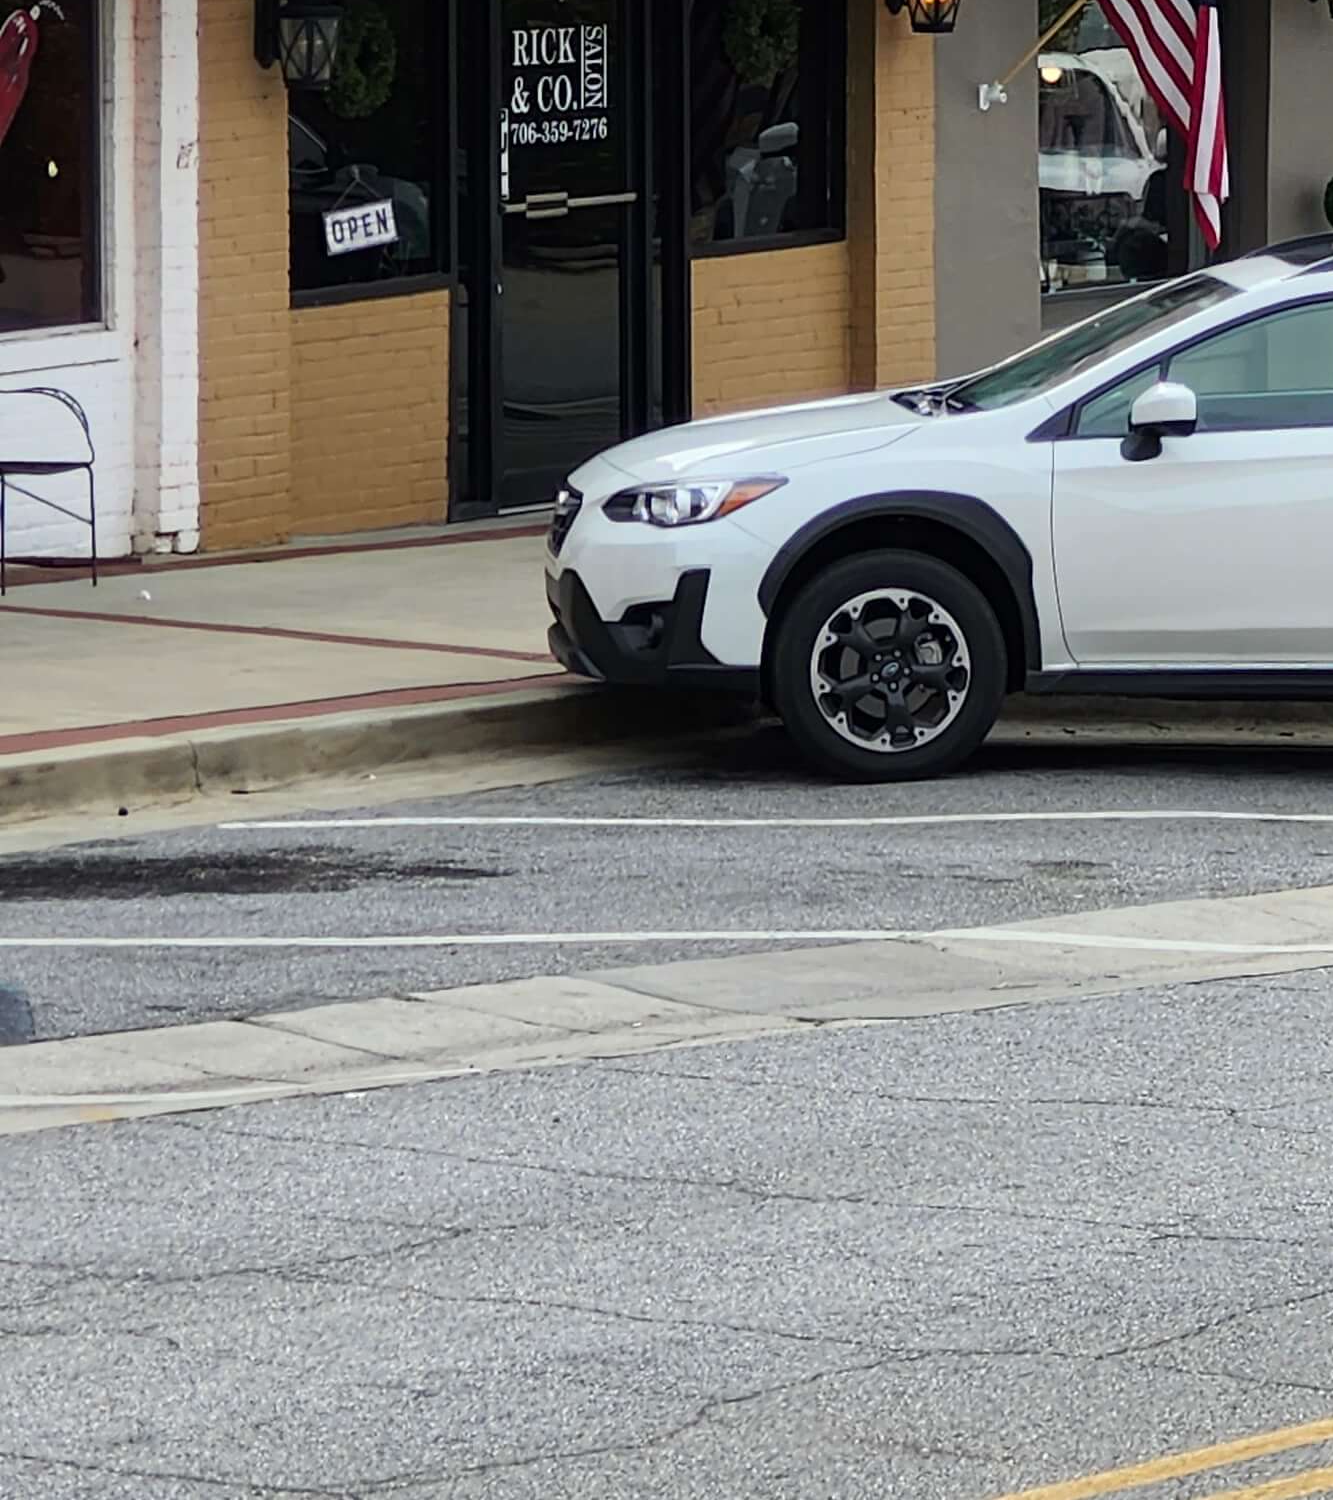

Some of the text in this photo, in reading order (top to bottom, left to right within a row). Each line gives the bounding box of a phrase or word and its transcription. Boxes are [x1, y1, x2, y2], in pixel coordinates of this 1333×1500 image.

[511, 27, 577, 66] RICK
[584, 25, 604, 108] SALON
[510, 74, 578, 114] & CO.
[510, 116, 608, 145] 706-359-7276
[331, 207, 389, 244] OPEN
